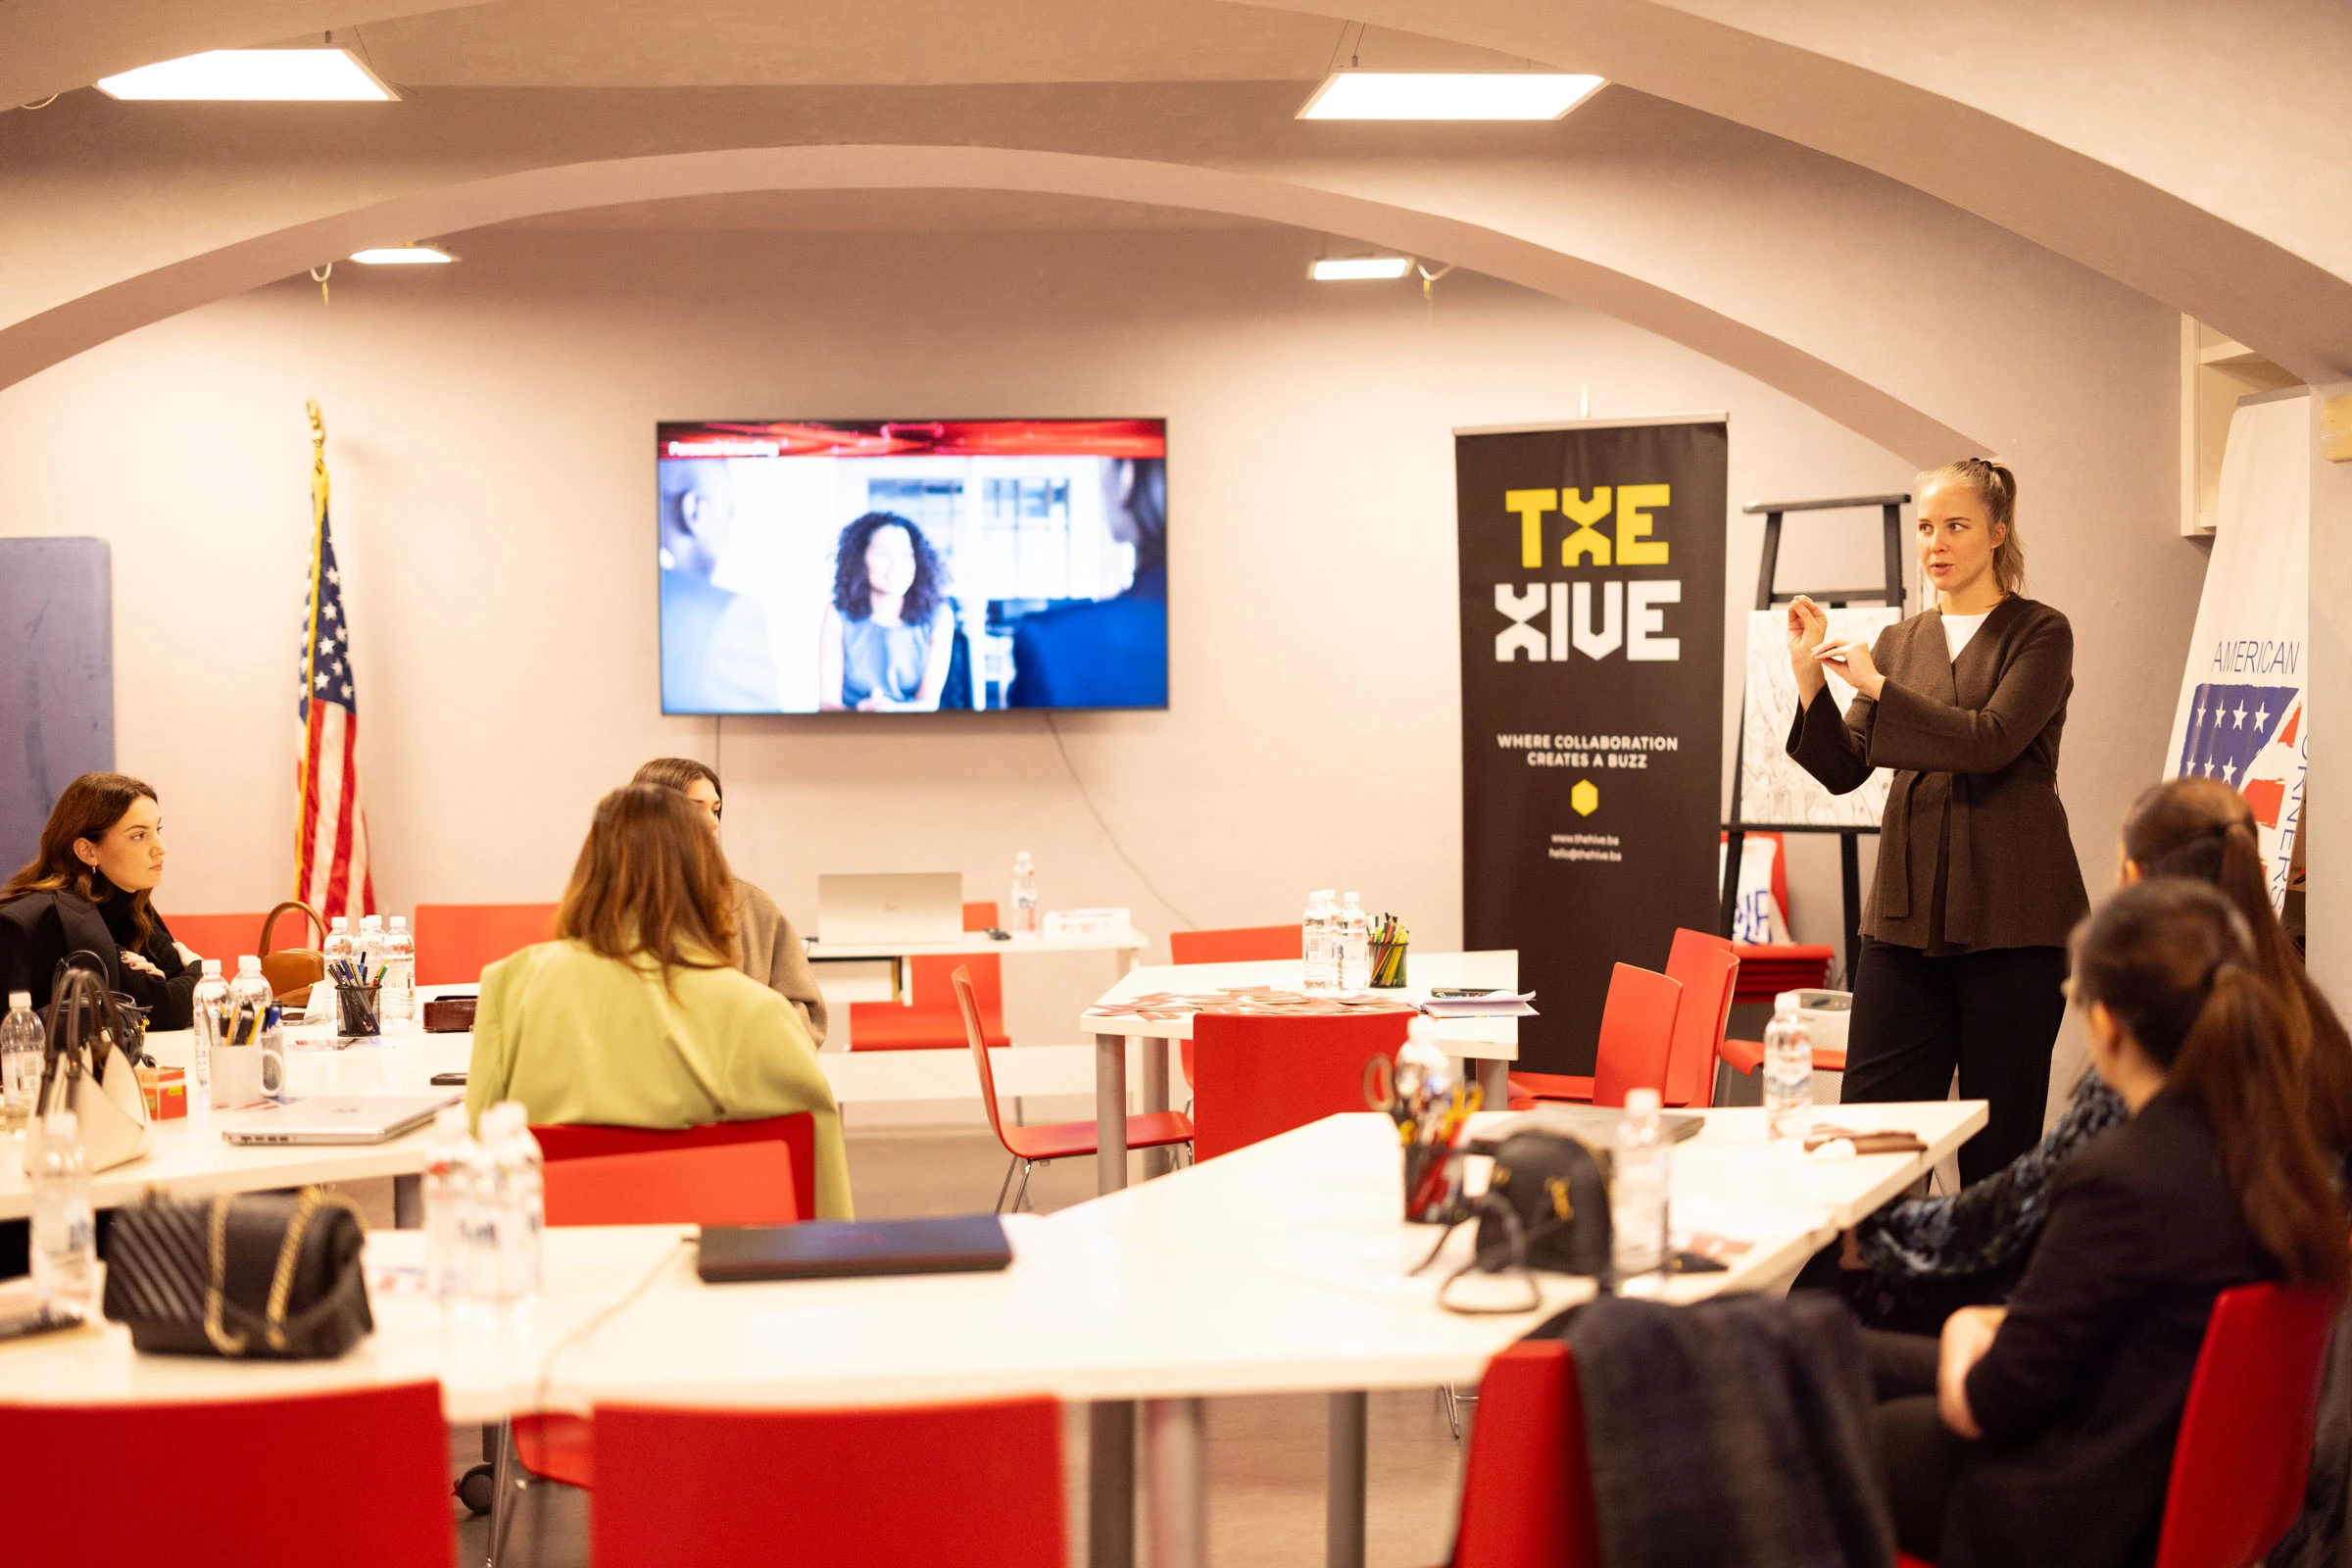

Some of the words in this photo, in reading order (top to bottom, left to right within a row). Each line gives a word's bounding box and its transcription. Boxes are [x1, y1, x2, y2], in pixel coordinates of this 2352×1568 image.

[2211, 640, 2300, 675] AMERICAN
[1496, 734, 1551, 750] WHERE
[1553, 735, 1679, 752] COLLABORATION
[1527, 752, 1590, 768] CREATES
[1592, 753, 1604, 768] A
[1607, 754, 1648, 769] BUZZ
